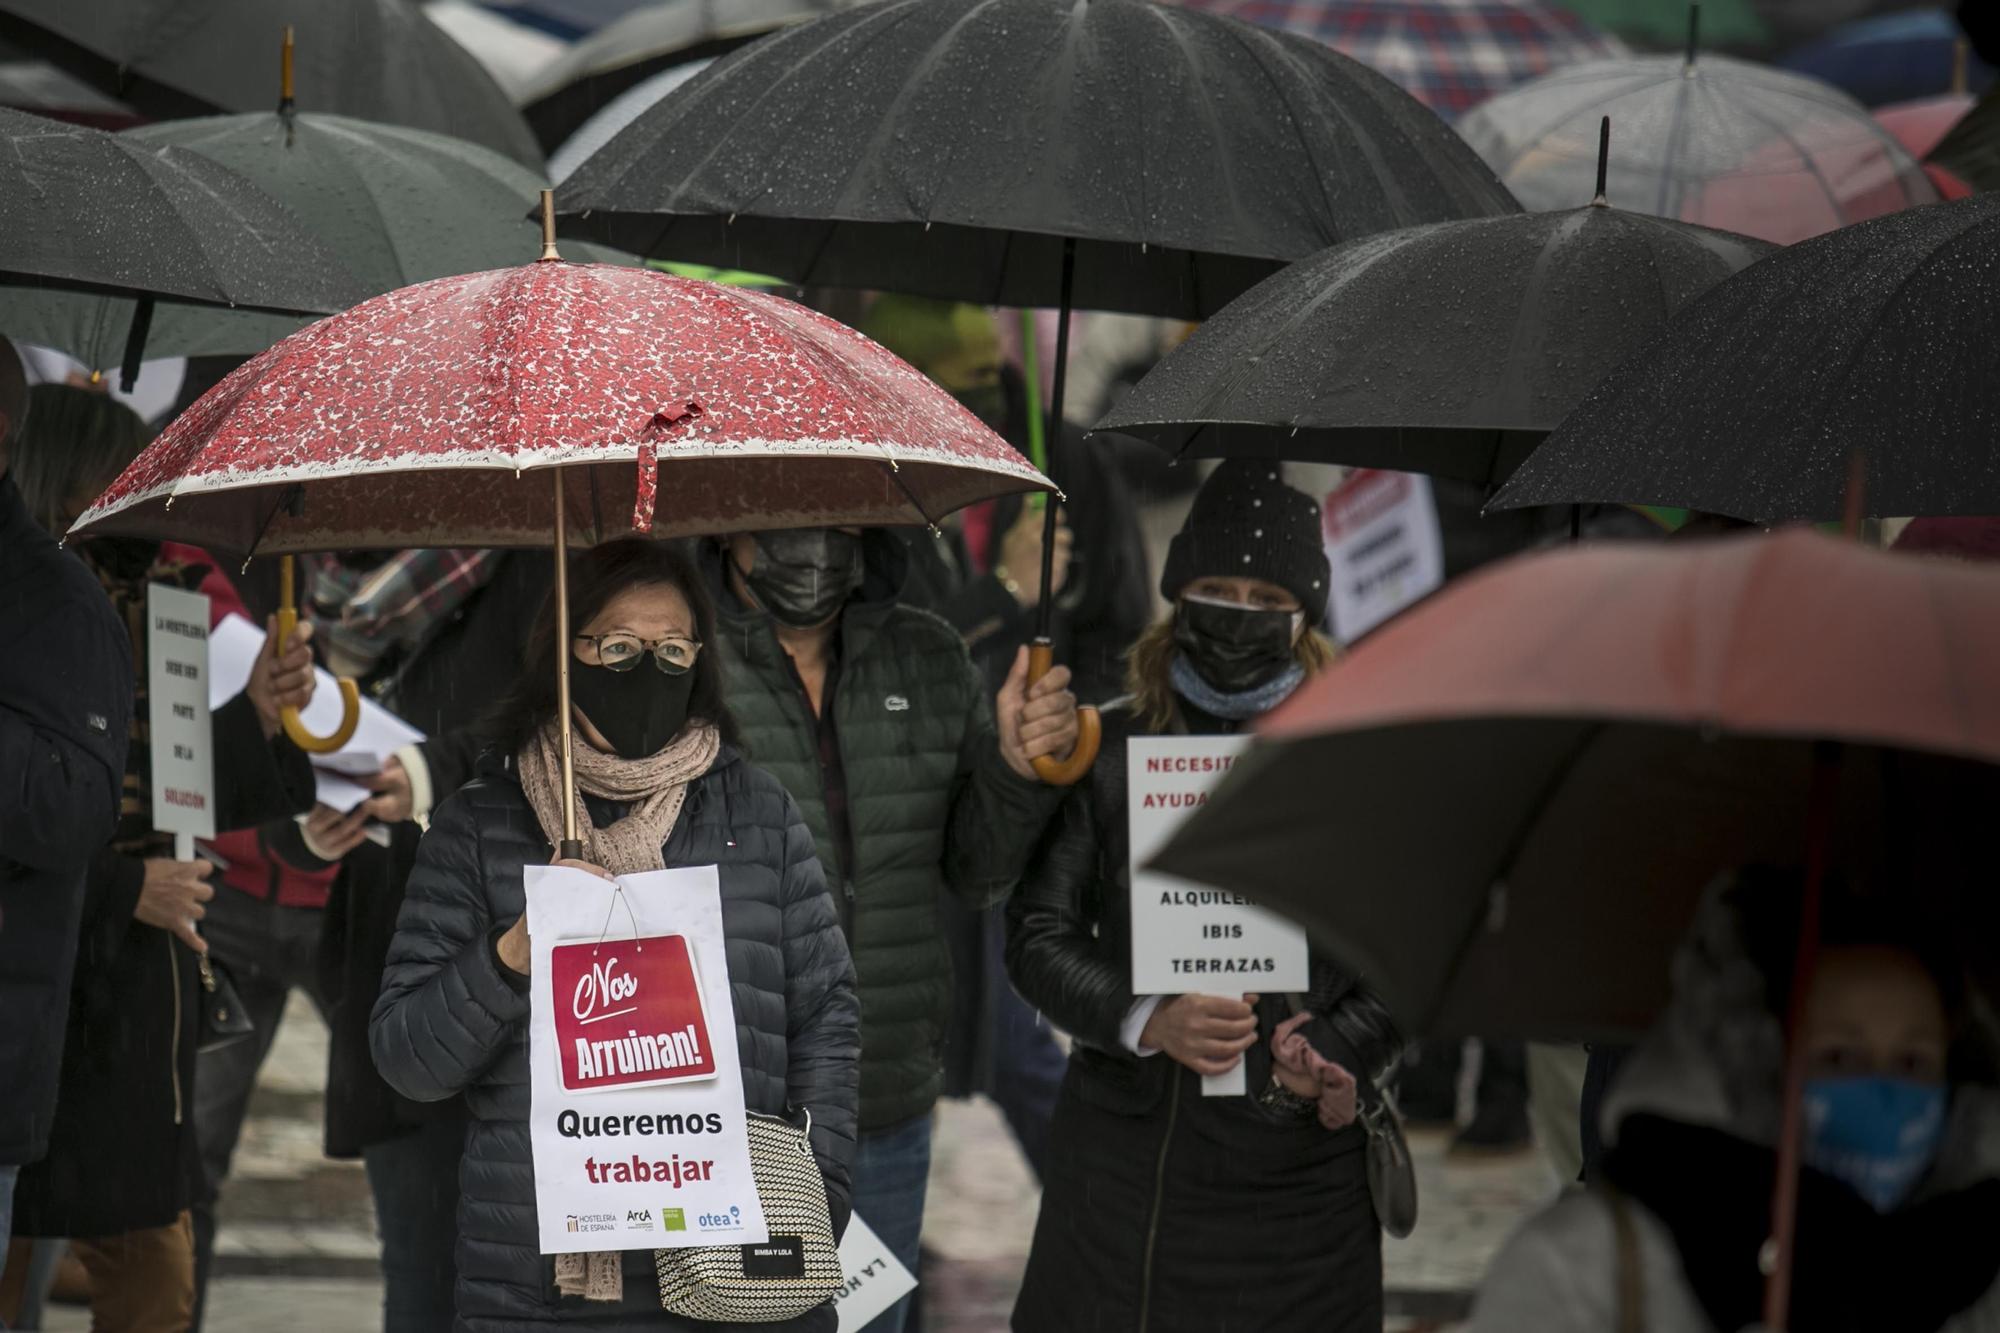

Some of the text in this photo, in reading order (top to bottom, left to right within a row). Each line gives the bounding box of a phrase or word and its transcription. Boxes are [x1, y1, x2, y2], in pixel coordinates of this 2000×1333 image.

[1143, 792, 1208, 809] AYUDA
[1203, 925, 1243, 939] IBIS
[1172, 958, 1275, 974] TERRAZAS
[573, 957, 638, 1019] Nos
[575, 1024, 703, 1080] Arruinan!
[557, 1109, 722, 1140] Queremos
[585, 1154, 714, 1189] trabajar
[580, 1224, 589, 1233] DE
[860, 1258, 886, 1278] LA
